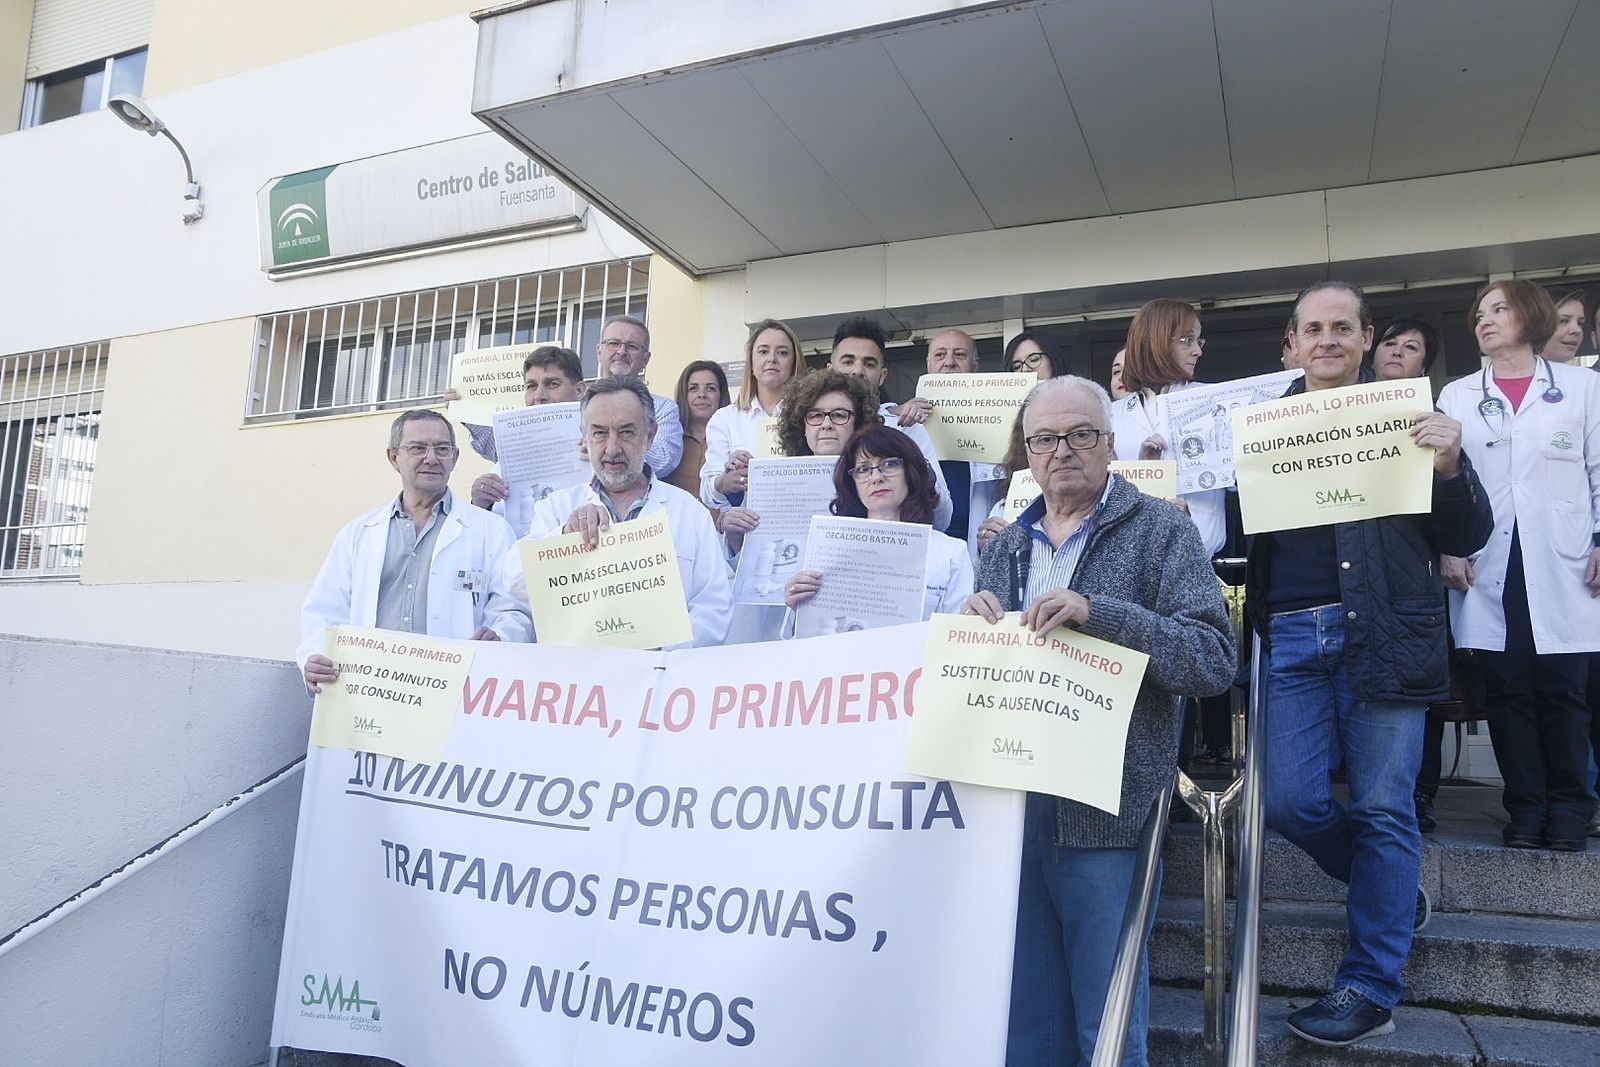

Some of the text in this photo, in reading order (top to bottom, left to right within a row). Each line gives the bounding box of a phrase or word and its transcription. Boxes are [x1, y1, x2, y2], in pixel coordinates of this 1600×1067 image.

[417, 175, 473, 201] Centro
[478, 166, 499, 189] de
[500, 183, 556, 207] Fuensanta
[502, 352, 513, 361] LO
[462, 375, 475, 384] NO
[477, 371, 496, 381] MÁS
[924, 378, 1028, 388] PRIMARIA, LO PRIMERO
[469, 387, 491, 396] DCCU
[928, 399, 1022, 407] RATAMOS PERSONAS
[542, 413, 564, 423] BASTA
[941, 413, 1002, 424] NO NÚMEROS
[1246, 387, 1416, 426] PRIMARIA, LO PRIMERO
[957, 438, 983, 449] SMA
[1243, 418, 1417, 454] EQUIPARACIÓN SALARIA
[800, 468, 821, 476] BASTA
[1272, 445, 1401, 475] CON RESTO CC.AA
[1315, 488, 1362, 504] SMA
[601, 535, 616, 548] LO
[619, 522, 664, 545] PRIMERO
[870, 534, 896, 545] BASTA
[897, 538, 908, 546] YA
[548, 552, 667, 588] NO MÁS ESCLAVOS EN
[561, 575, 666, 607] DCCU Y URGENCIAS
[595, 616, 632, 633] SMA
[337, 635, 462, 664] PRIMARIA, LO PRIMERO
[948, 629, 1123, 676] PRIMARIA, LO PRIMERO
[374, 667, 390, 679] 10
[391, 671, 449, 690] MINUTOS
[941, 664, 1114, 711] SUSTITUCIÓN DE TODAS
[360, 685, 423, 707] CONSULTA
[967, 692, 1081, 722] LAS AUSENCIAS
[637, 686, 696, 733] LO
[353, 715, 382, 731] SMA
[992, 737, 1032, 756] SMA
[347, 750, 966, 832] 10 MINUTOS POR CONSULTA
[380, 839, 600, 918] TRATAMOS
[608, 877, 857, 943] PERSONAS
[301, 972, 377, 1012] SMA
[443, 948, 756, 1048] NO NÚMEROS
